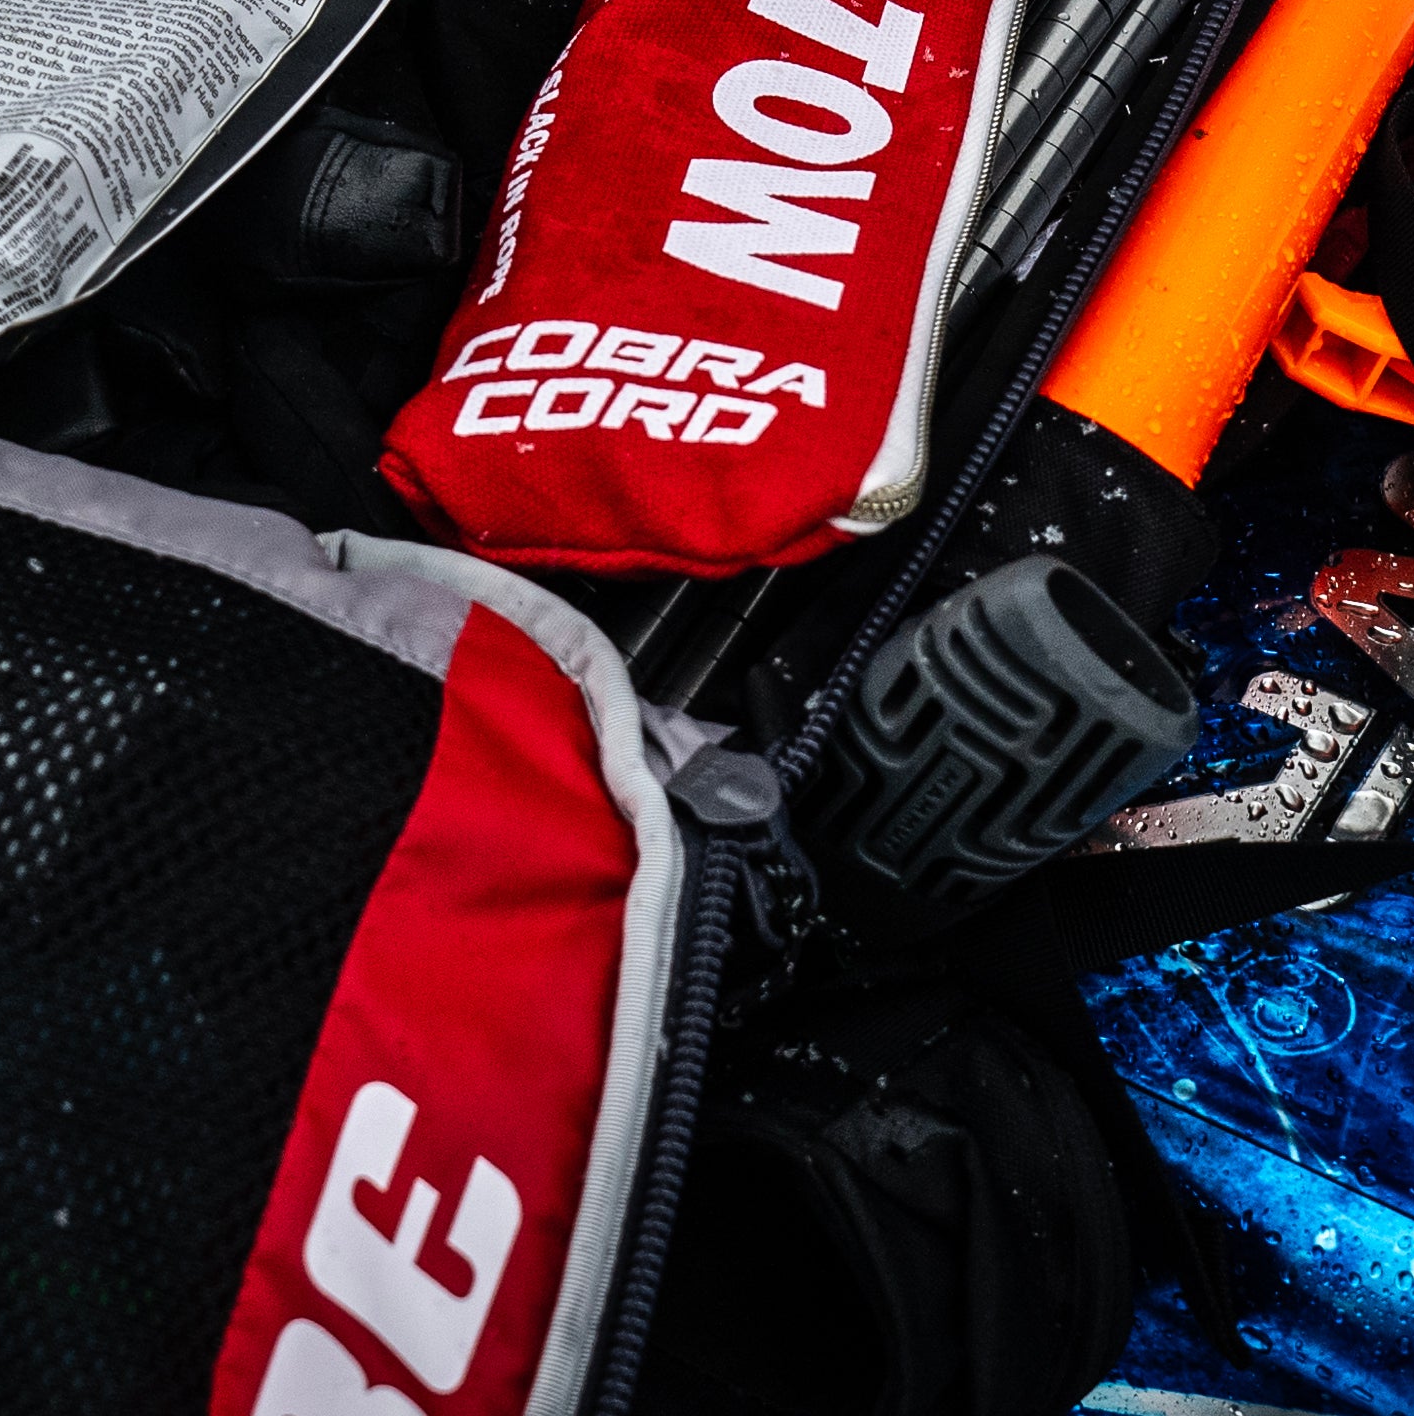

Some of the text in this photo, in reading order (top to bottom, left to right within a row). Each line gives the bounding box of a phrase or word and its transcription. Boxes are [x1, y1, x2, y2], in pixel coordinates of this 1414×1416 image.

[477, 69, 563, 306] SLACK IN ROPE
[441, 319, 828, 408] COBRA
[451, 377, 780, 446] CORD
